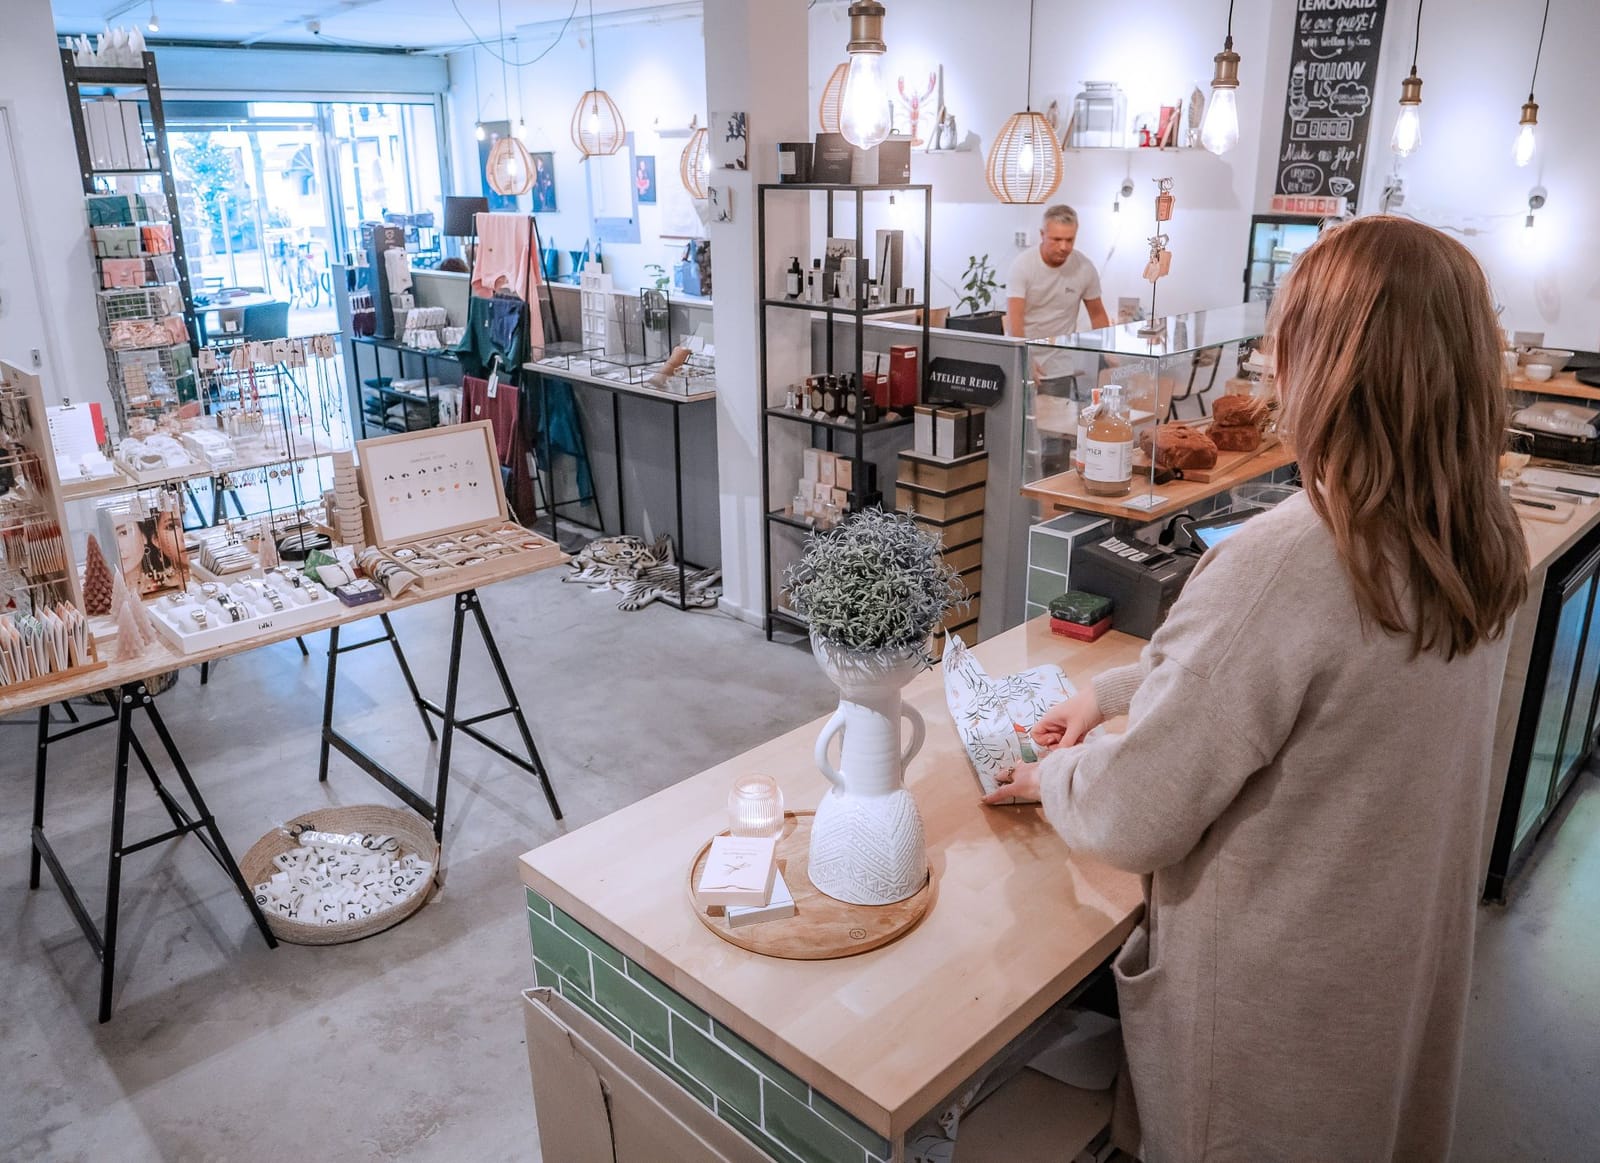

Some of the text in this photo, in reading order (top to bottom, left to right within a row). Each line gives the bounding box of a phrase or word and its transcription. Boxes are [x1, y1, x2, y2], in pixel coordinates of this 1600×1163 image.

[1308, 61, 1366, 80] FOLLOW
[1313, 80, 1332, 97] US
[930, 370, 999, 391] ATELIER REBUL
